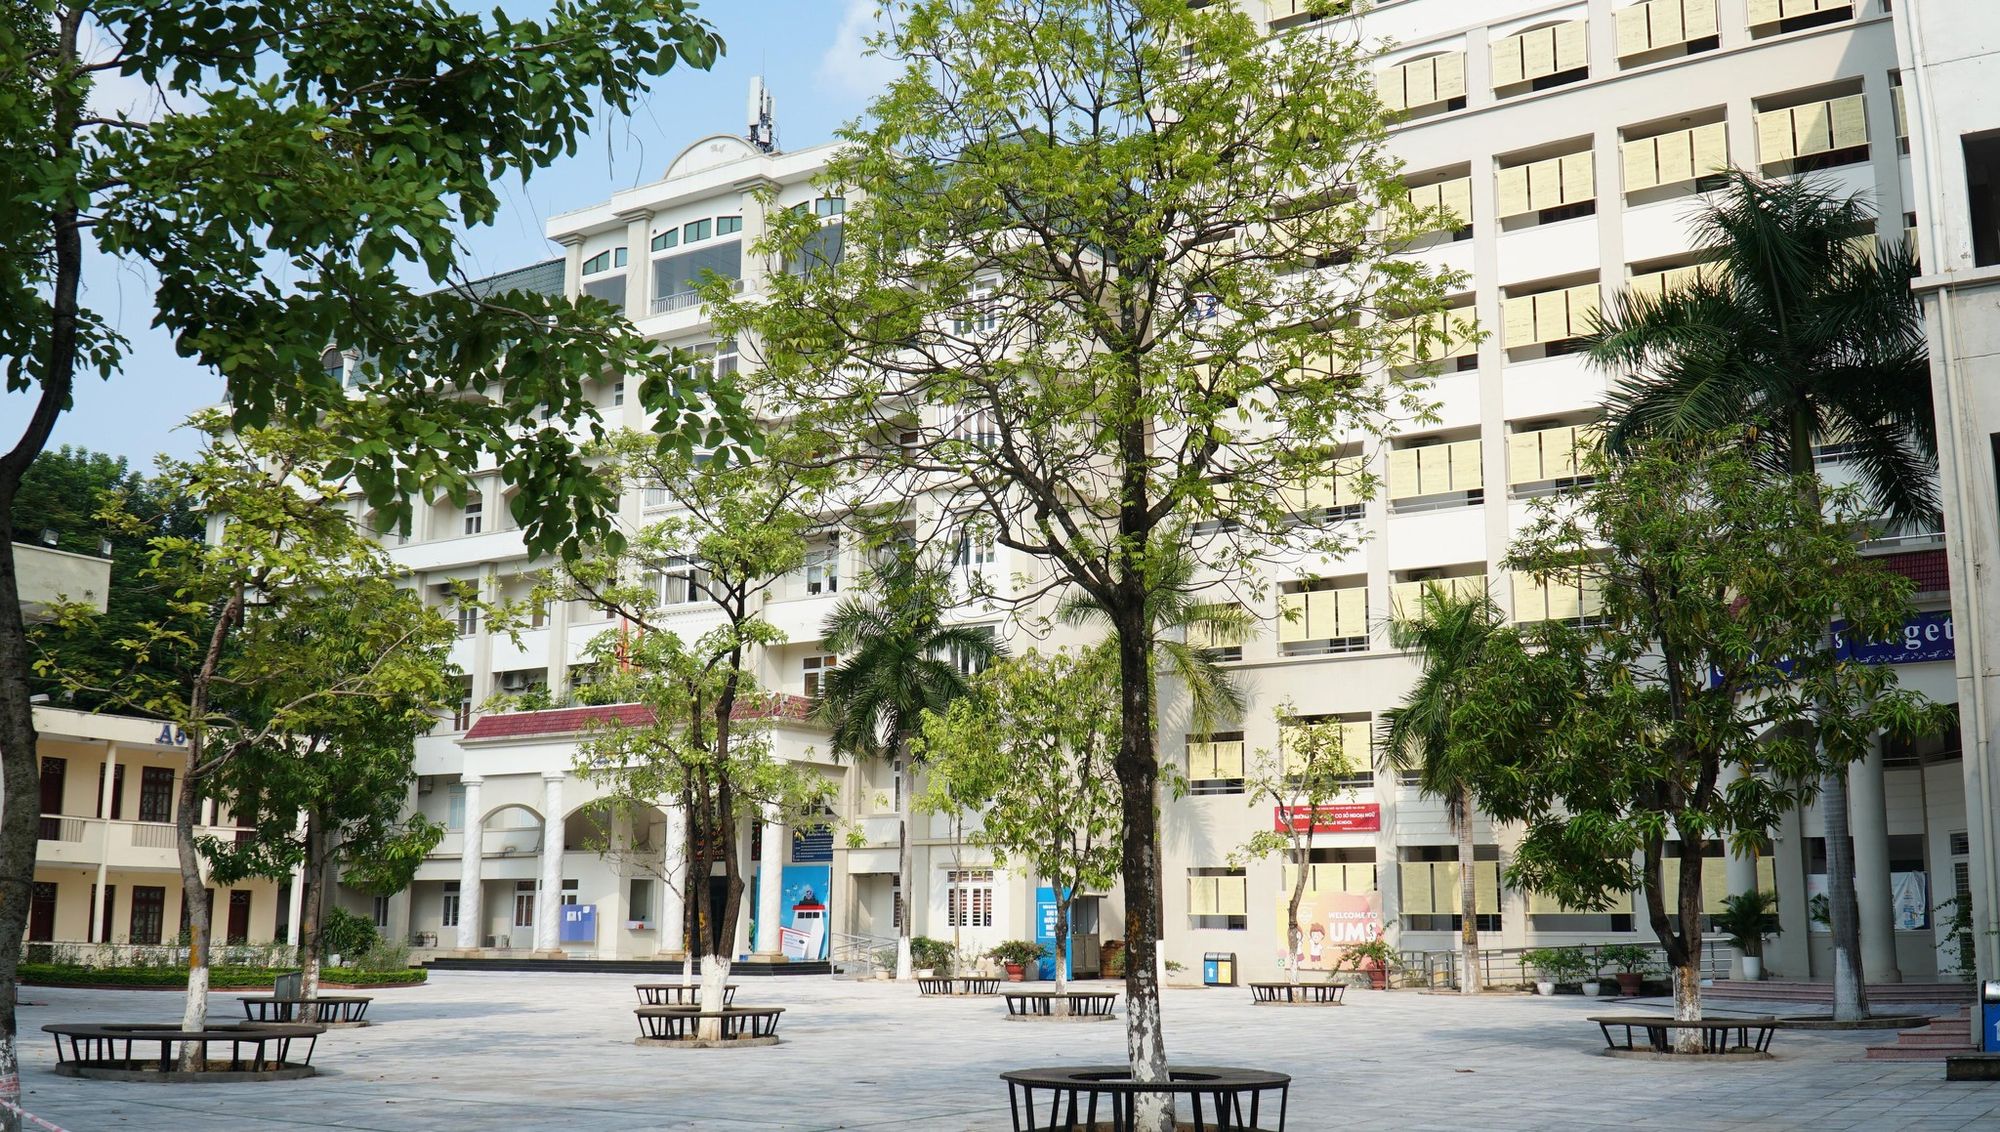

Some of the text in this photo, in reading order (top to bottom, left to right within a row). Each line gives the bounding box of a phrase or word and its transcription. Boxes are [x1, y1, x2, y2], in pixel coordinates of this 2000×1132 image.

[1328, 911, 1378, 919] WELCOME TO
[1329, 921, 1377, 942] UMS
